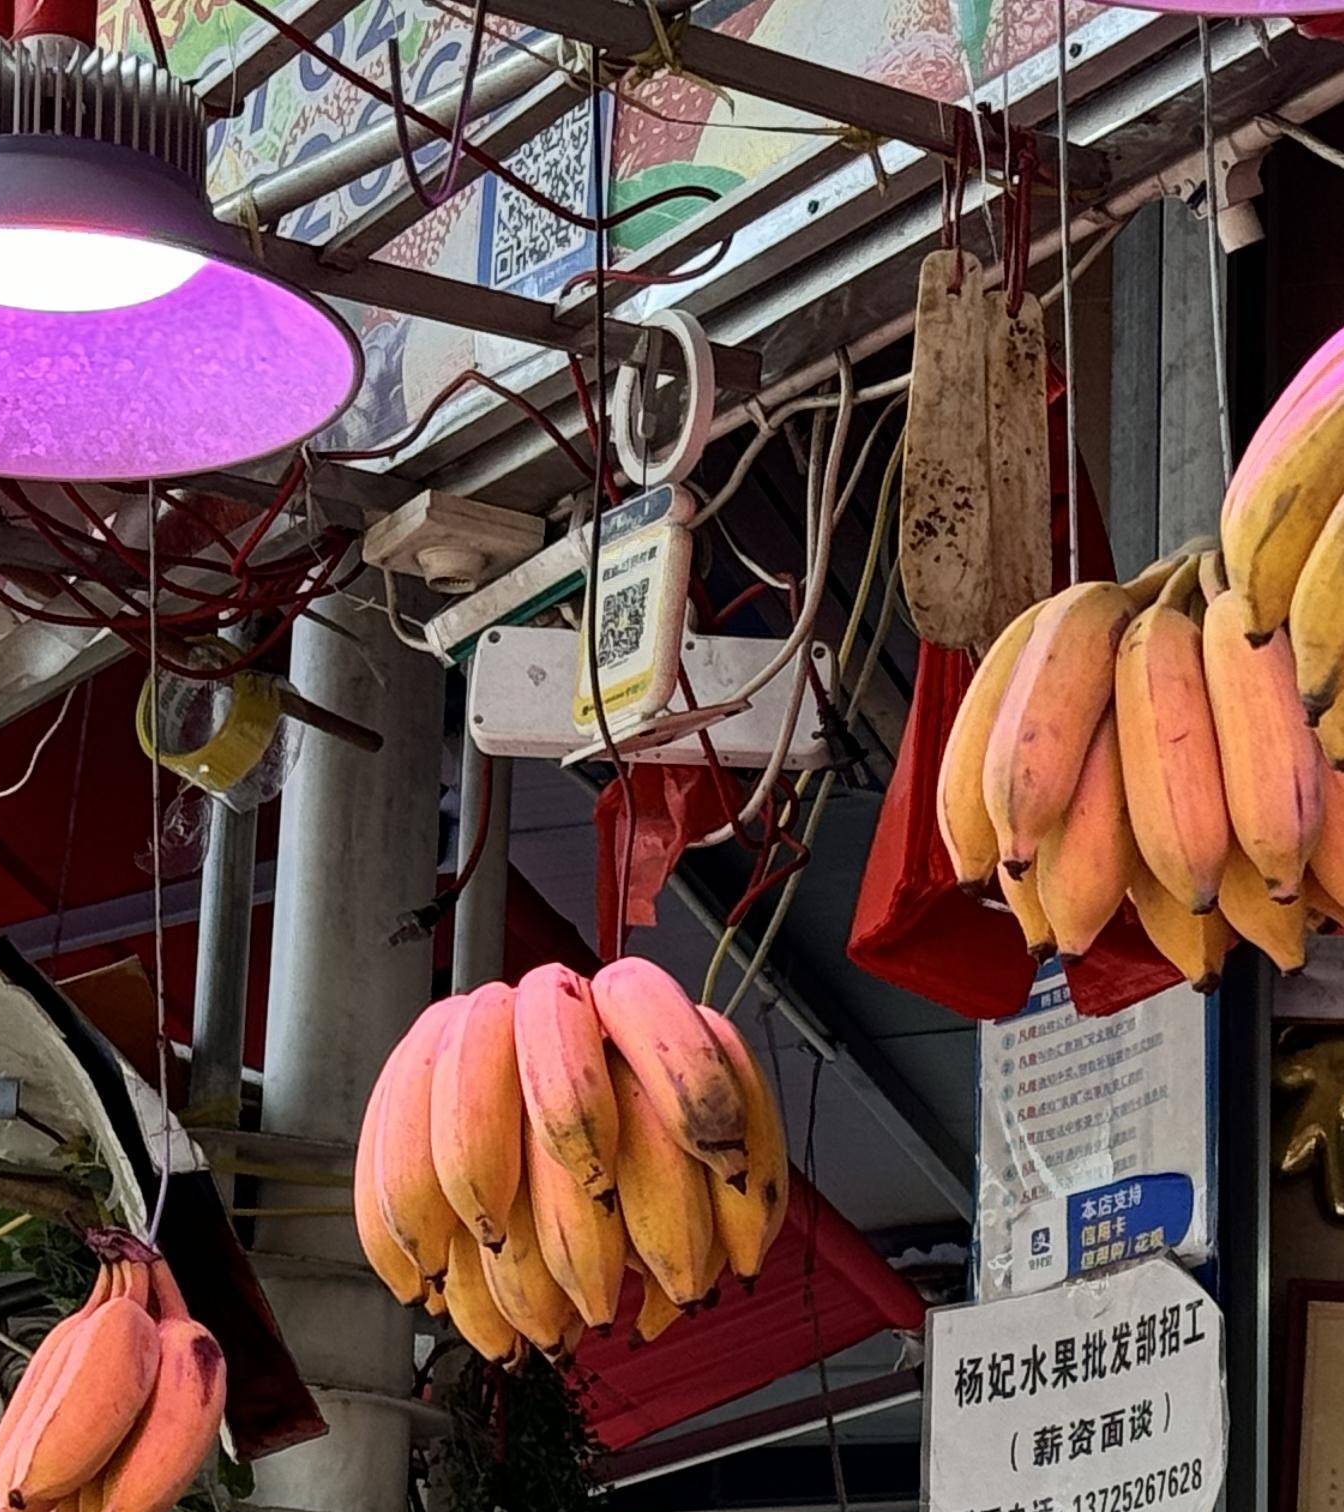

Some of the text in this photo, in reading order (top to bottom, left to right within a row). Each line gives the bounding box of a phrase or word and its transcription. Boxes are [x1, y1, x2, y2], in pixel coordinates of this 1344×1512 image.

[1080, 1182, 1143, 1221] 本店支持
[1080, 1218, 1127, 1248] 信用卡
[953, 1298, 1206, 1409] 杨妃水果批发部招工
